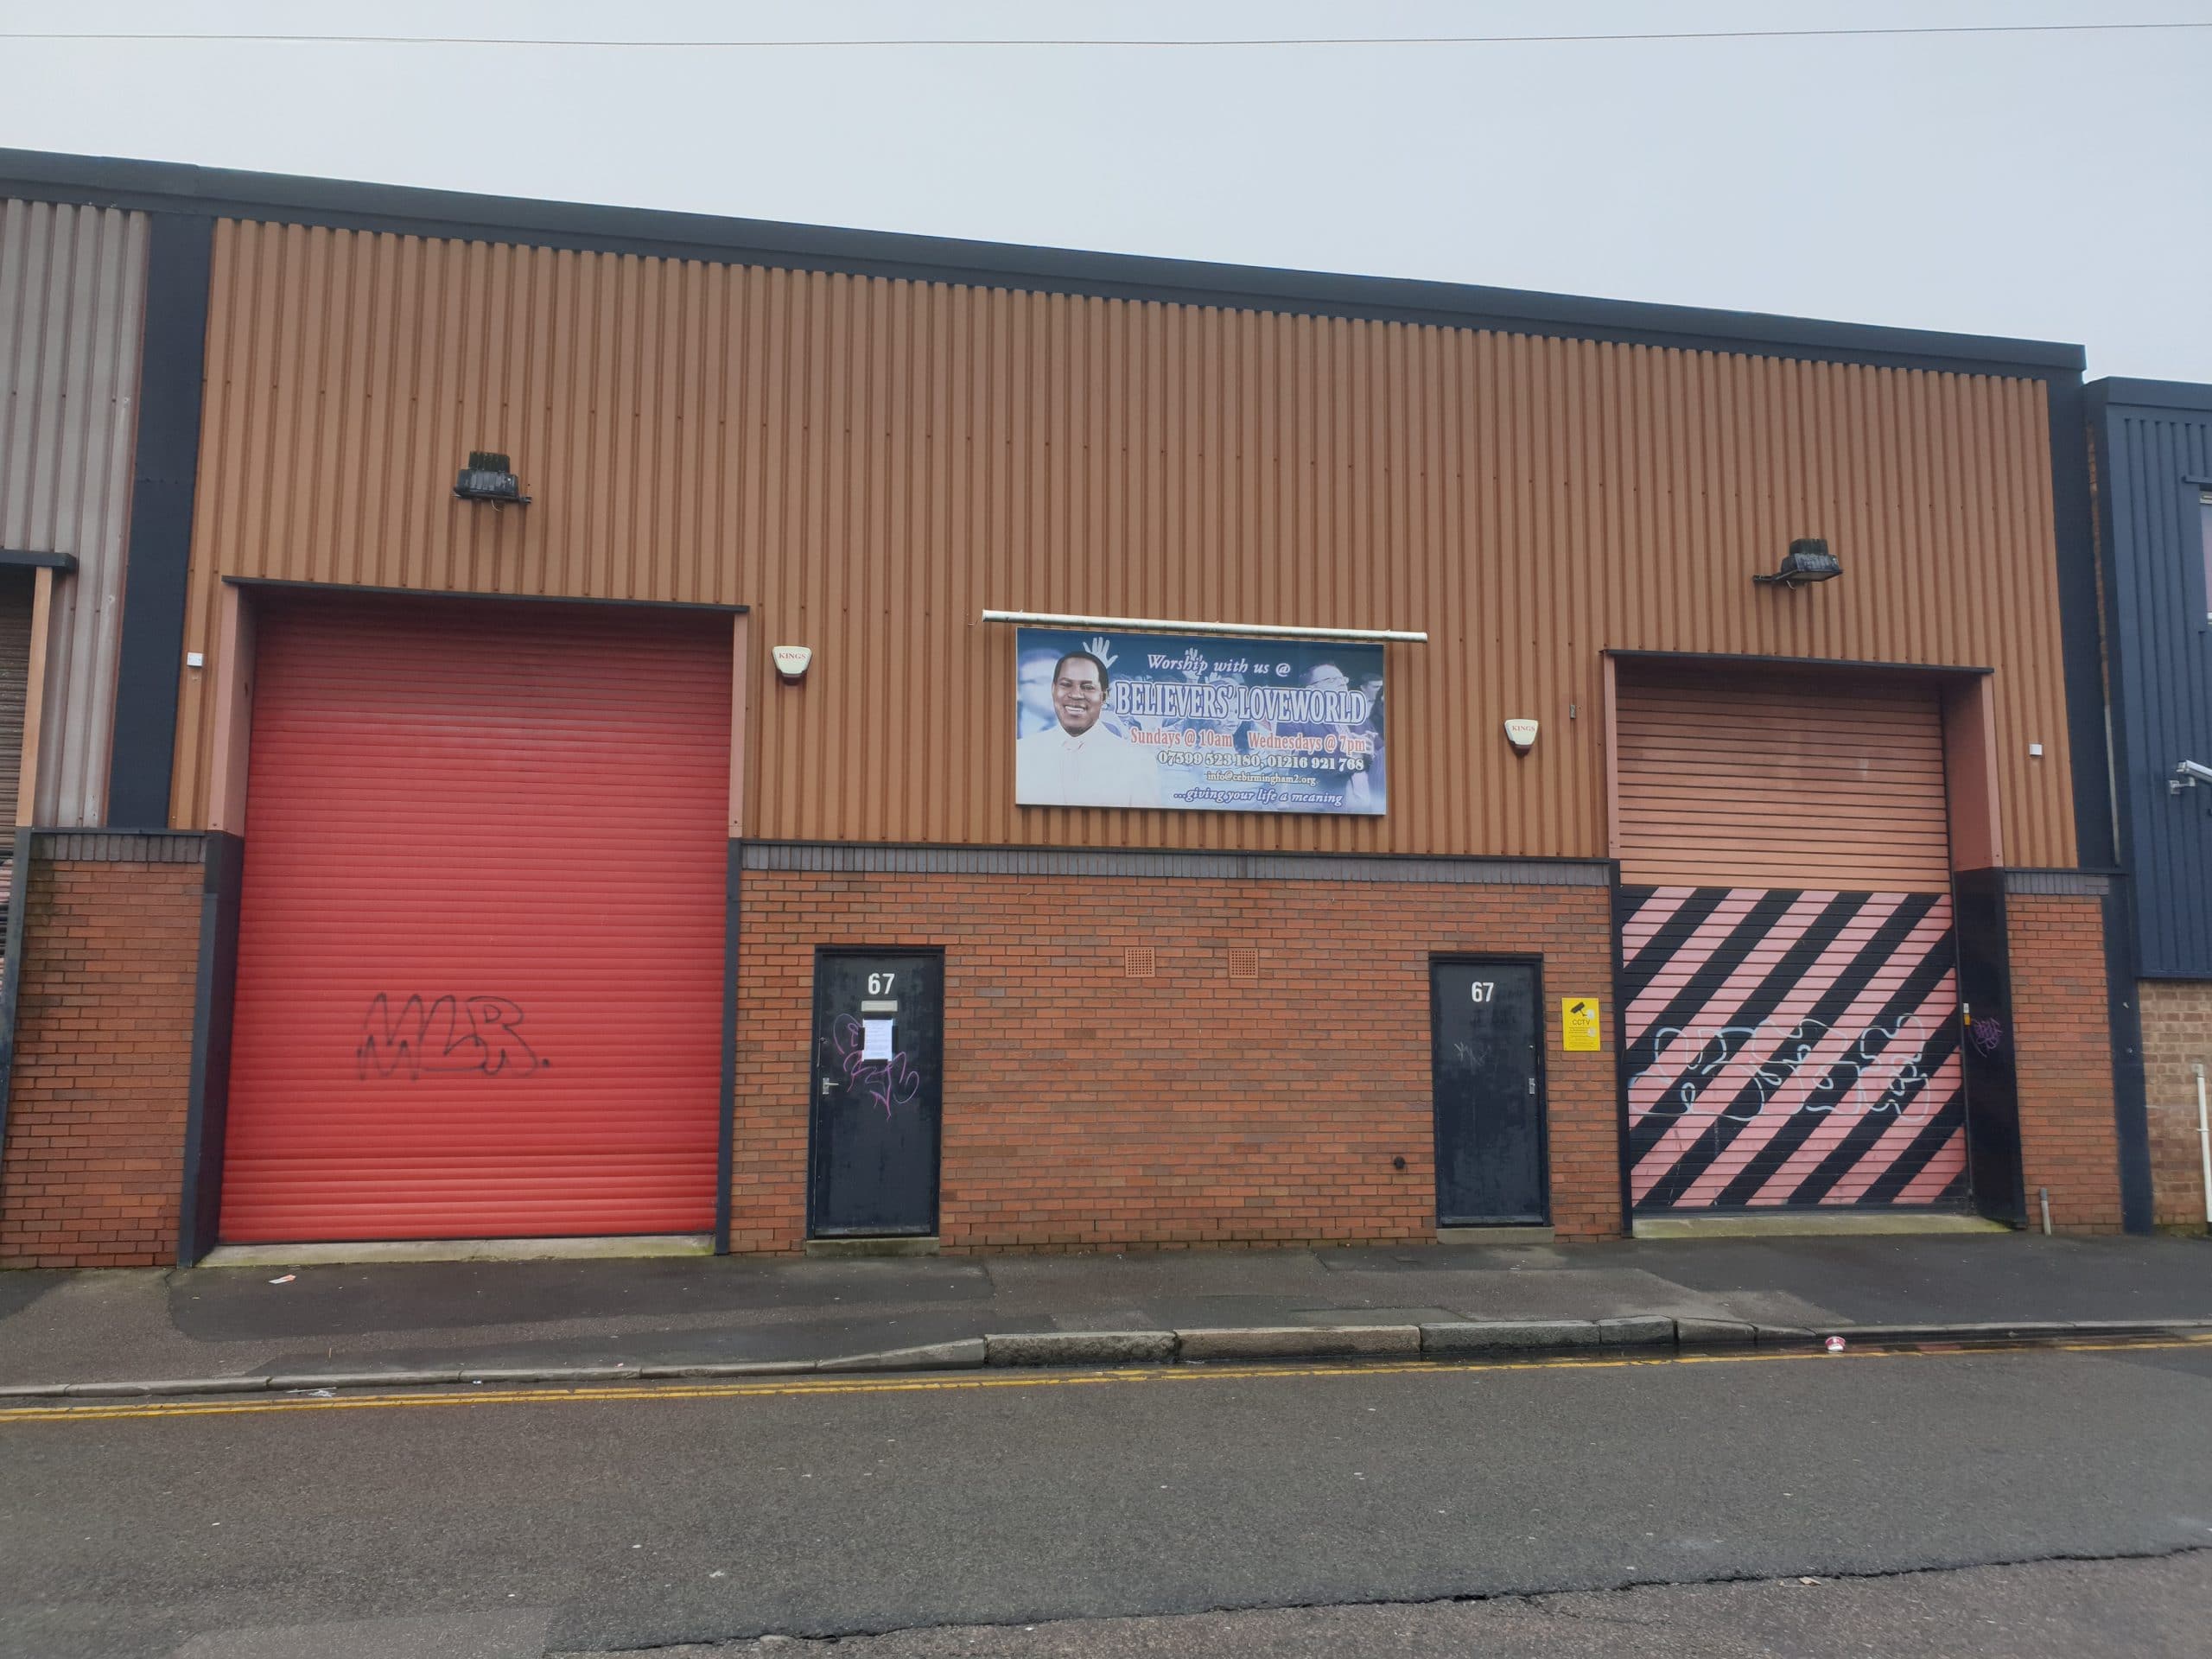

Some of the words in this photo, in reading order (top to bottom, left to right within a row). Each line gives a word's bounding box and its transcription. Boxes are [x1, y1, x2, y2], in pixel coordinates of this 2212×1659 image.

[1147, 653, 1208, 675] Worship
[1214, 658, 1248, 673] with
[1254, 664, 1270, 674] us
[1275, 663, 1291, 677] @
[1116, 682, 1234, 721] BELIEVERS'
[1236, 686, 1368, 725] LOVEWORLD
[1130, 728, 1180, 748] Sundays
[1185, 729, 1196, 747] @
[1199, 730, 1233, 747] 10am
[1248, 732, 1322, 753] Wednesdays
[1325, 735, 1337, 752] @
[1340, 735, 1366, 755] 7pm
[1311, 757, 1335, 770] 921
[1225, 791, 1255, 804] your
[1257, 788, 1277, 804] life
[1280, 792, 1287, 801] a
[1292, 792, 1343, 806] meaning
[868, 973, 895, 995] 67
[1471, 982, 1494, 1002] 67
